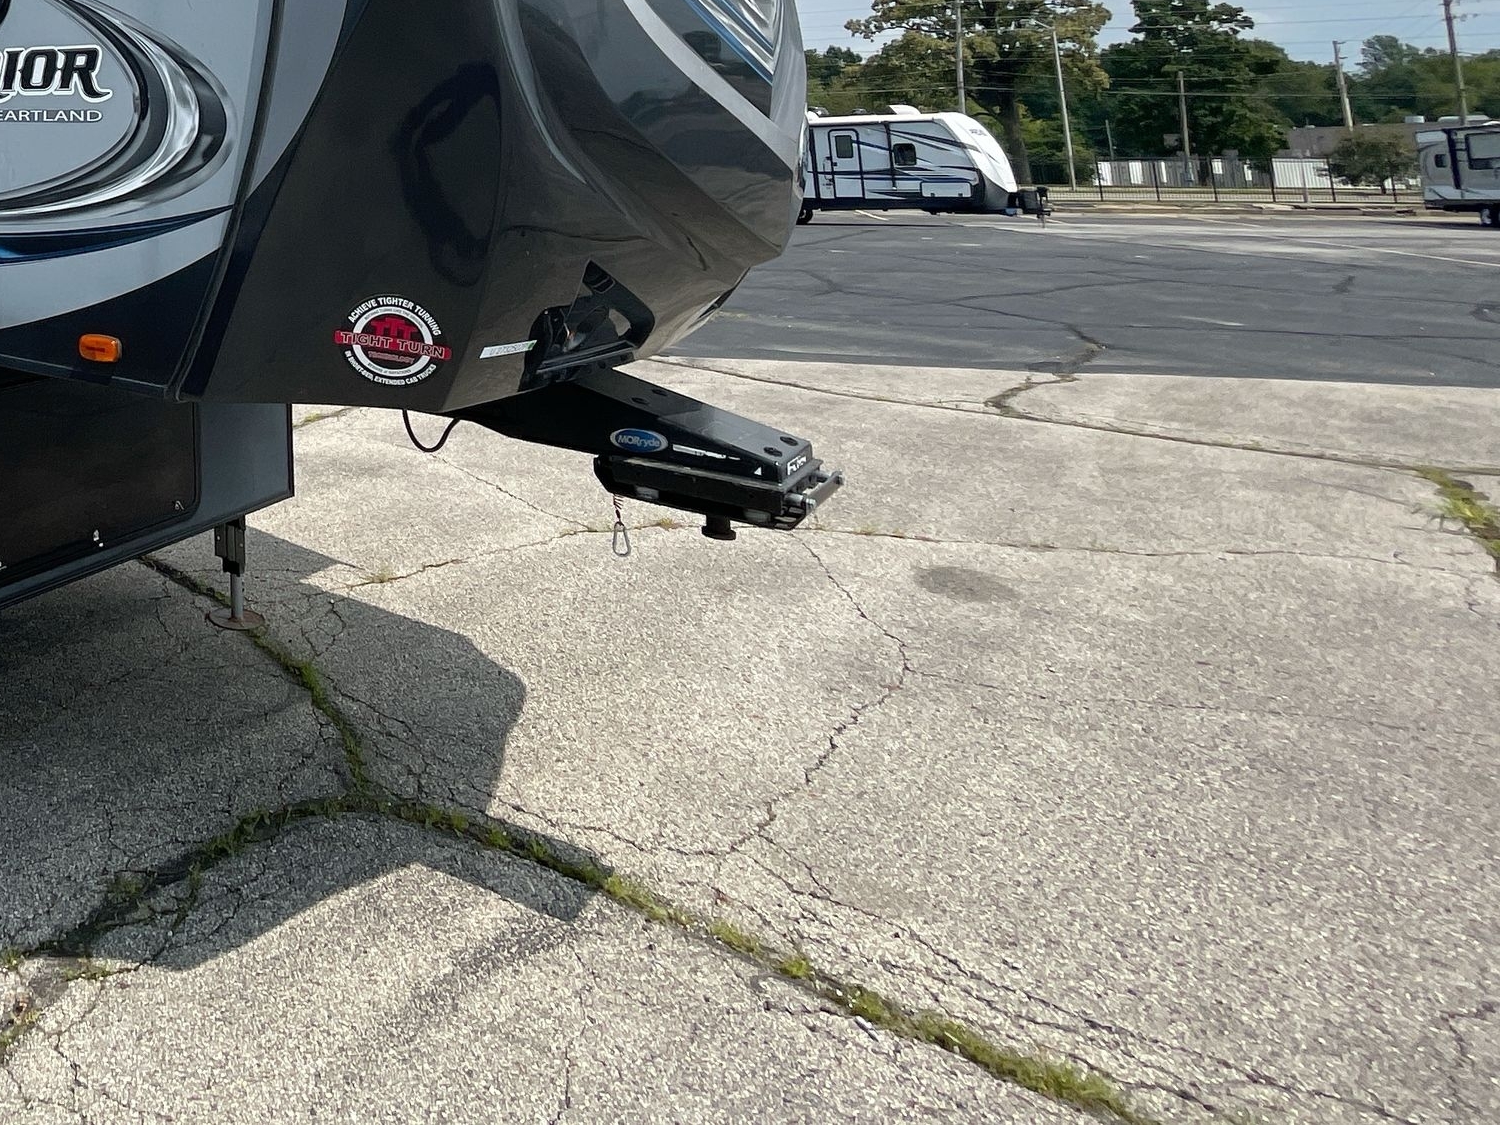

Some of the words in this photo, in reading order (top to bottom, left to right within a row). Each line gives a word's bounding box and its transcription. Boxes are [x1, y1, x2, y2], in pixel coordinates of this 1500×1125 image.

[347, 297, 378, 324] ACHIEVE
[377, 296, 415, 310] TIGHTER
[414, 304, 442, 336] TURNING
[340, 331, 393, 349] TIGHT
[396, 338, 446, 360] TURN
[373, 375, 406, 386] EXTENDED
[405, 375, 419, 385] CAB
